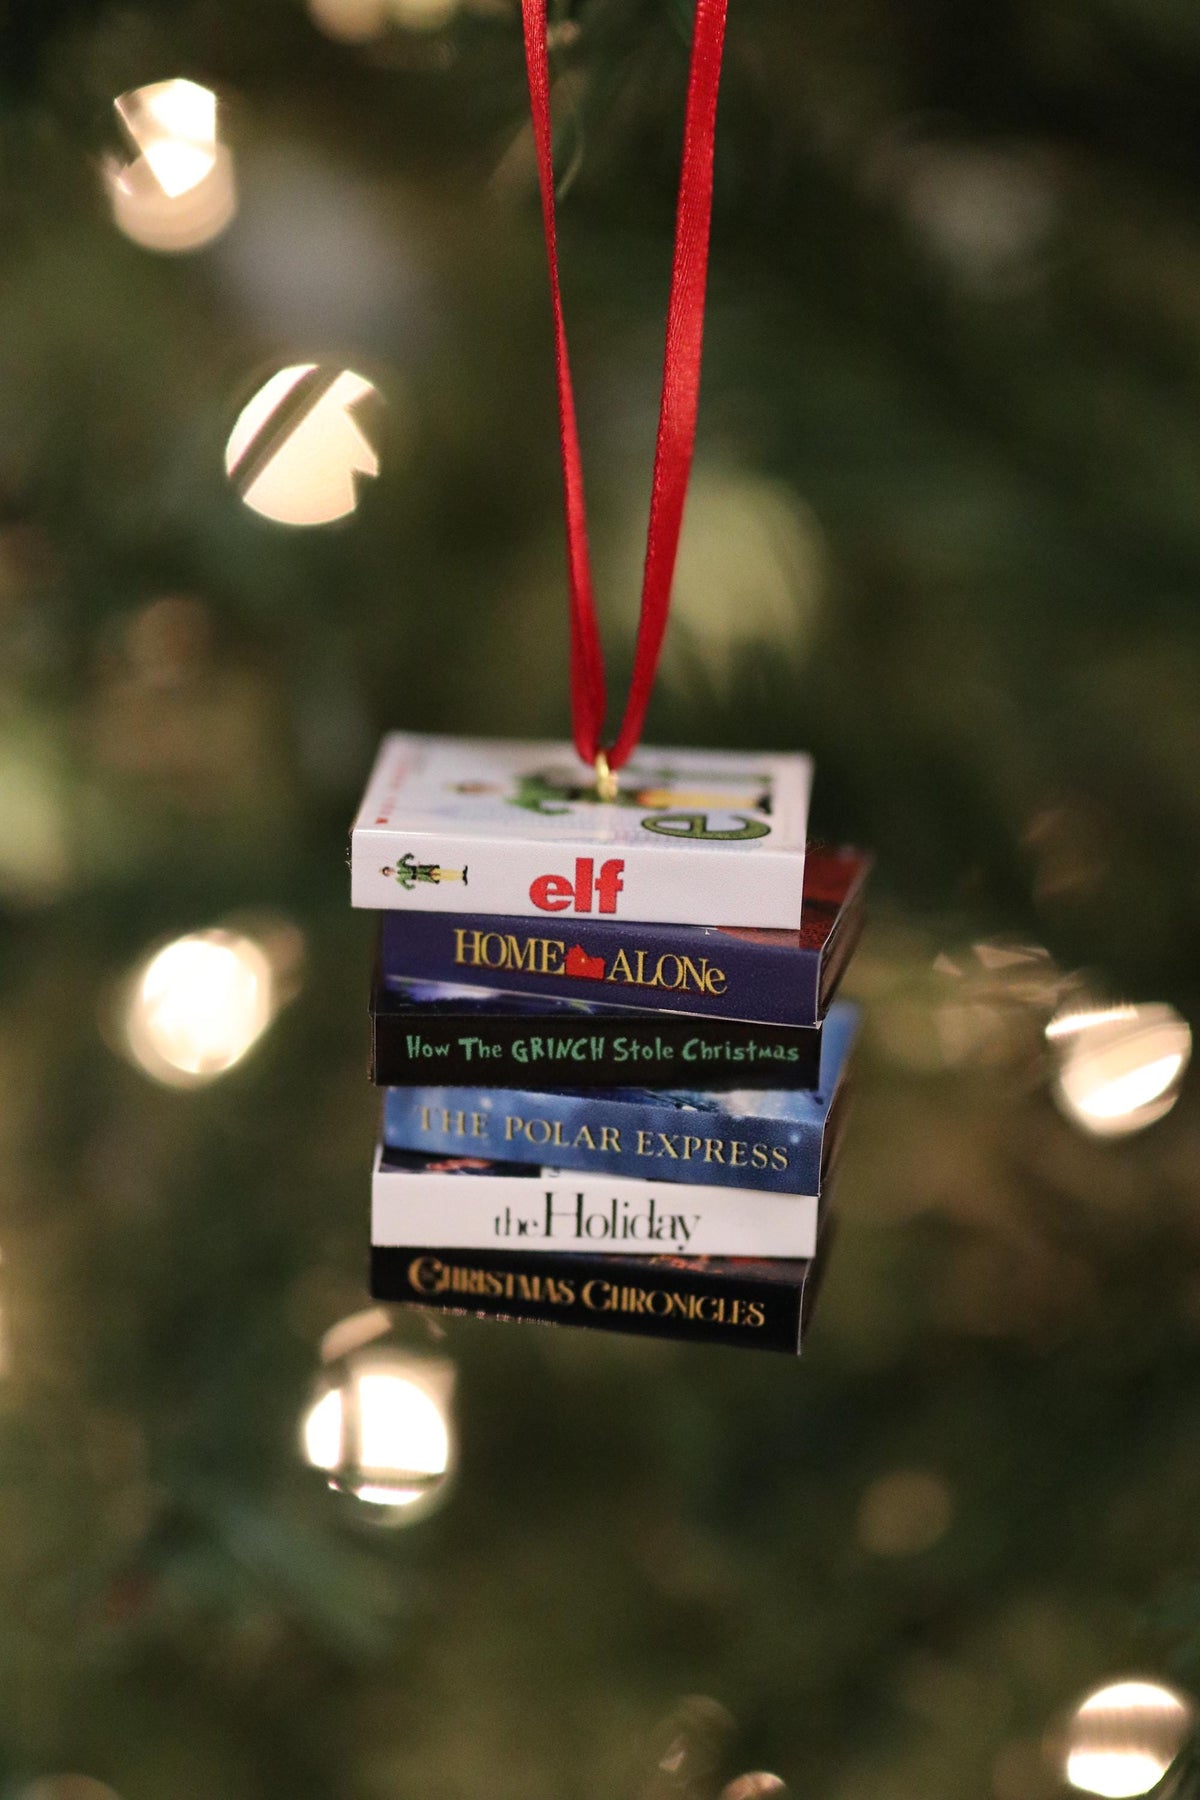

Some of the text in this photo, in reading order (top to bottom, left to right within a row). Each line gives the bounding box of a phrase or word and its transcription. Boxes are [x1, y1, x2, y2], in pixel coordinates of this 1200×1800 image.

[529, 858, 625, 914] elf
[455, 929, 566, 975] HOME
[406, 1035, 799, 1063] How The GRINCH Stole Christmas
[417, 1107, 791, 1171] THE POLAR EXPRESS
[408, 1256, 575, 1305] CHRISTMAS
[581, 1280, 766, 1328] CHRONICLES
